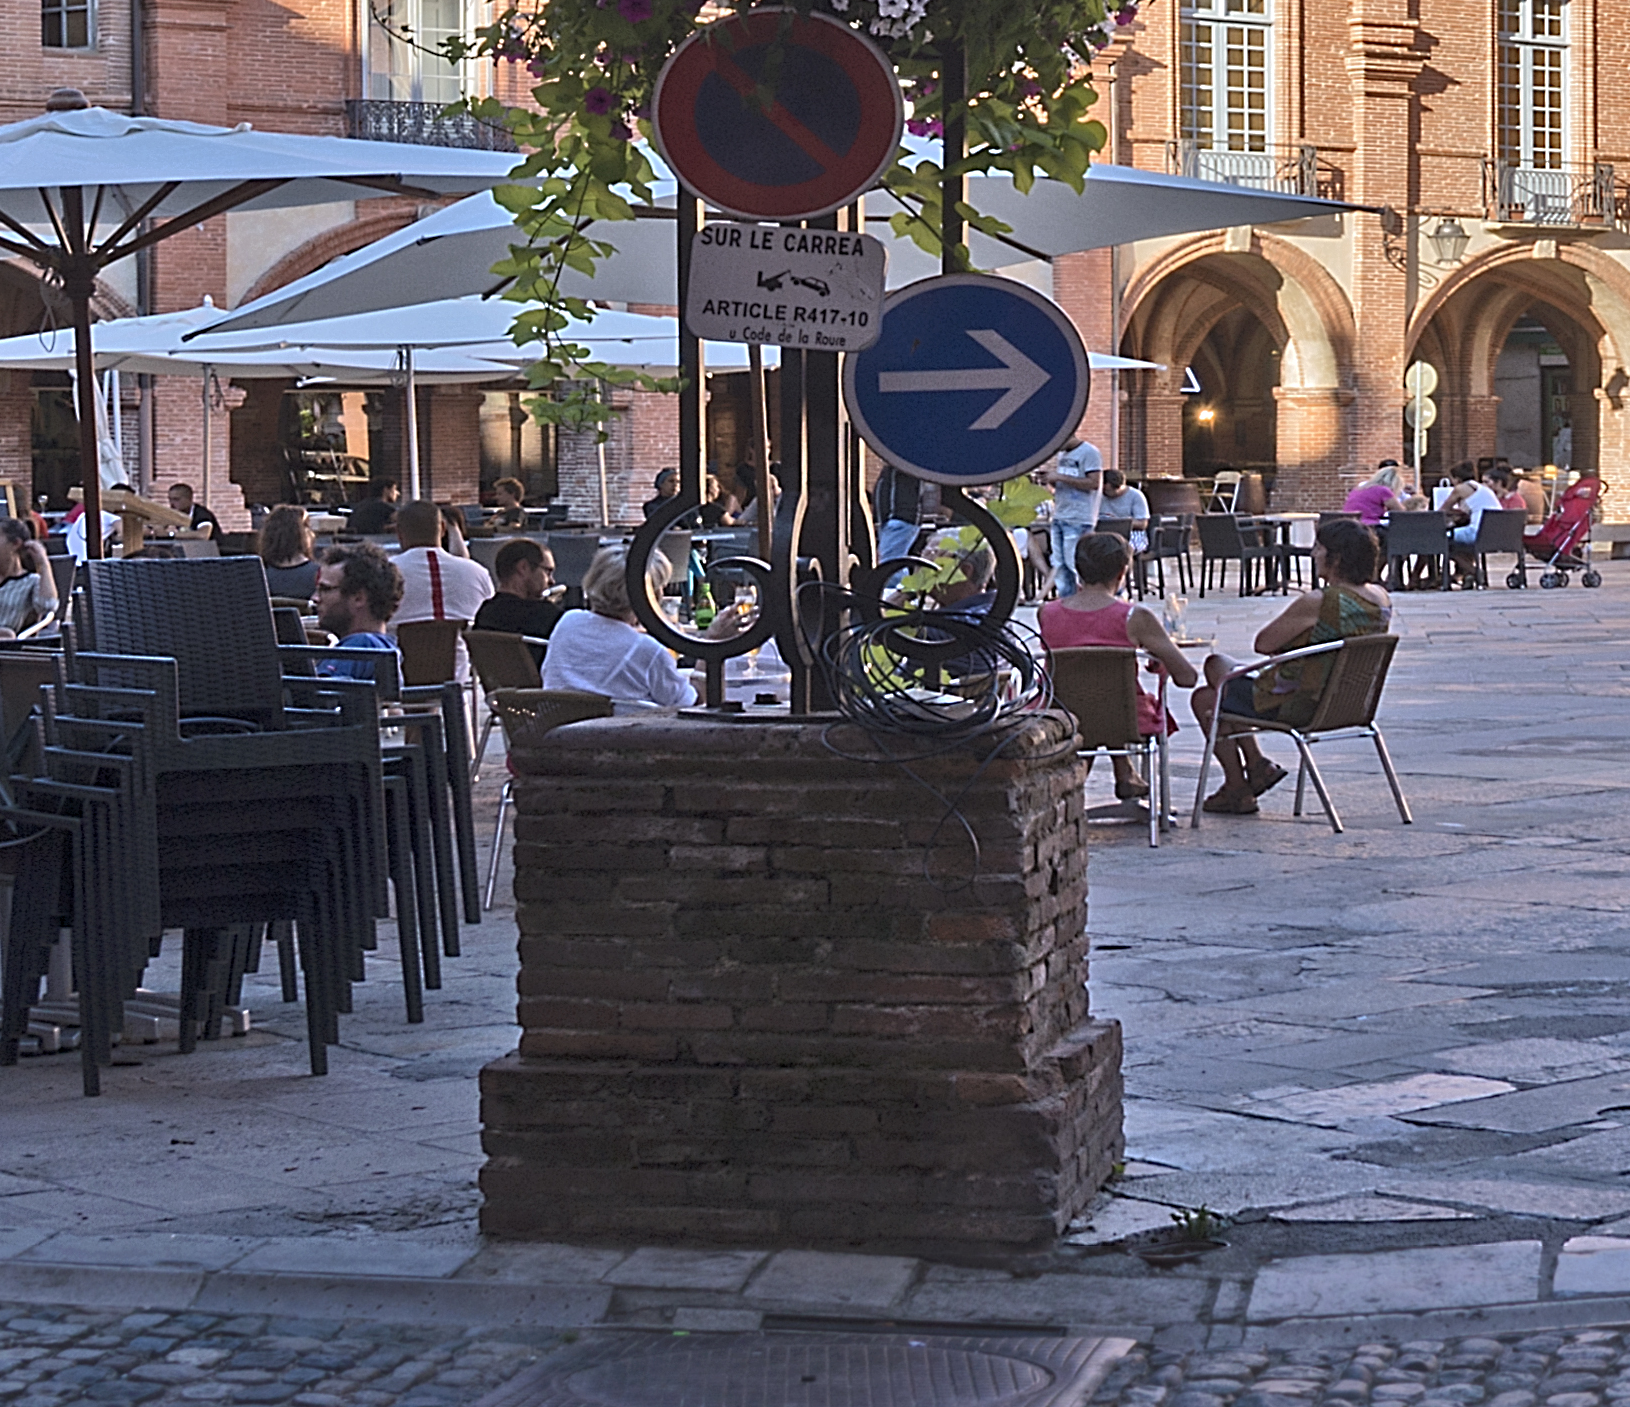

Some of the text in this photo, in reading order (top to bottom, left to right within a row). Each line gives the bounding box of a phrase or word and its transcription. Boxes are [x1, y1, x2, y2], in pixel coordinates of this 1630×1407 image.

[701, 227, 864, 257] SUR LE CARREA
[702, 299, 869, 327] ARTICLE R417-10
[743, 326, 771, 342] Code
[778, 327, 792, 343] de
[798, 328, 809, 344] la
